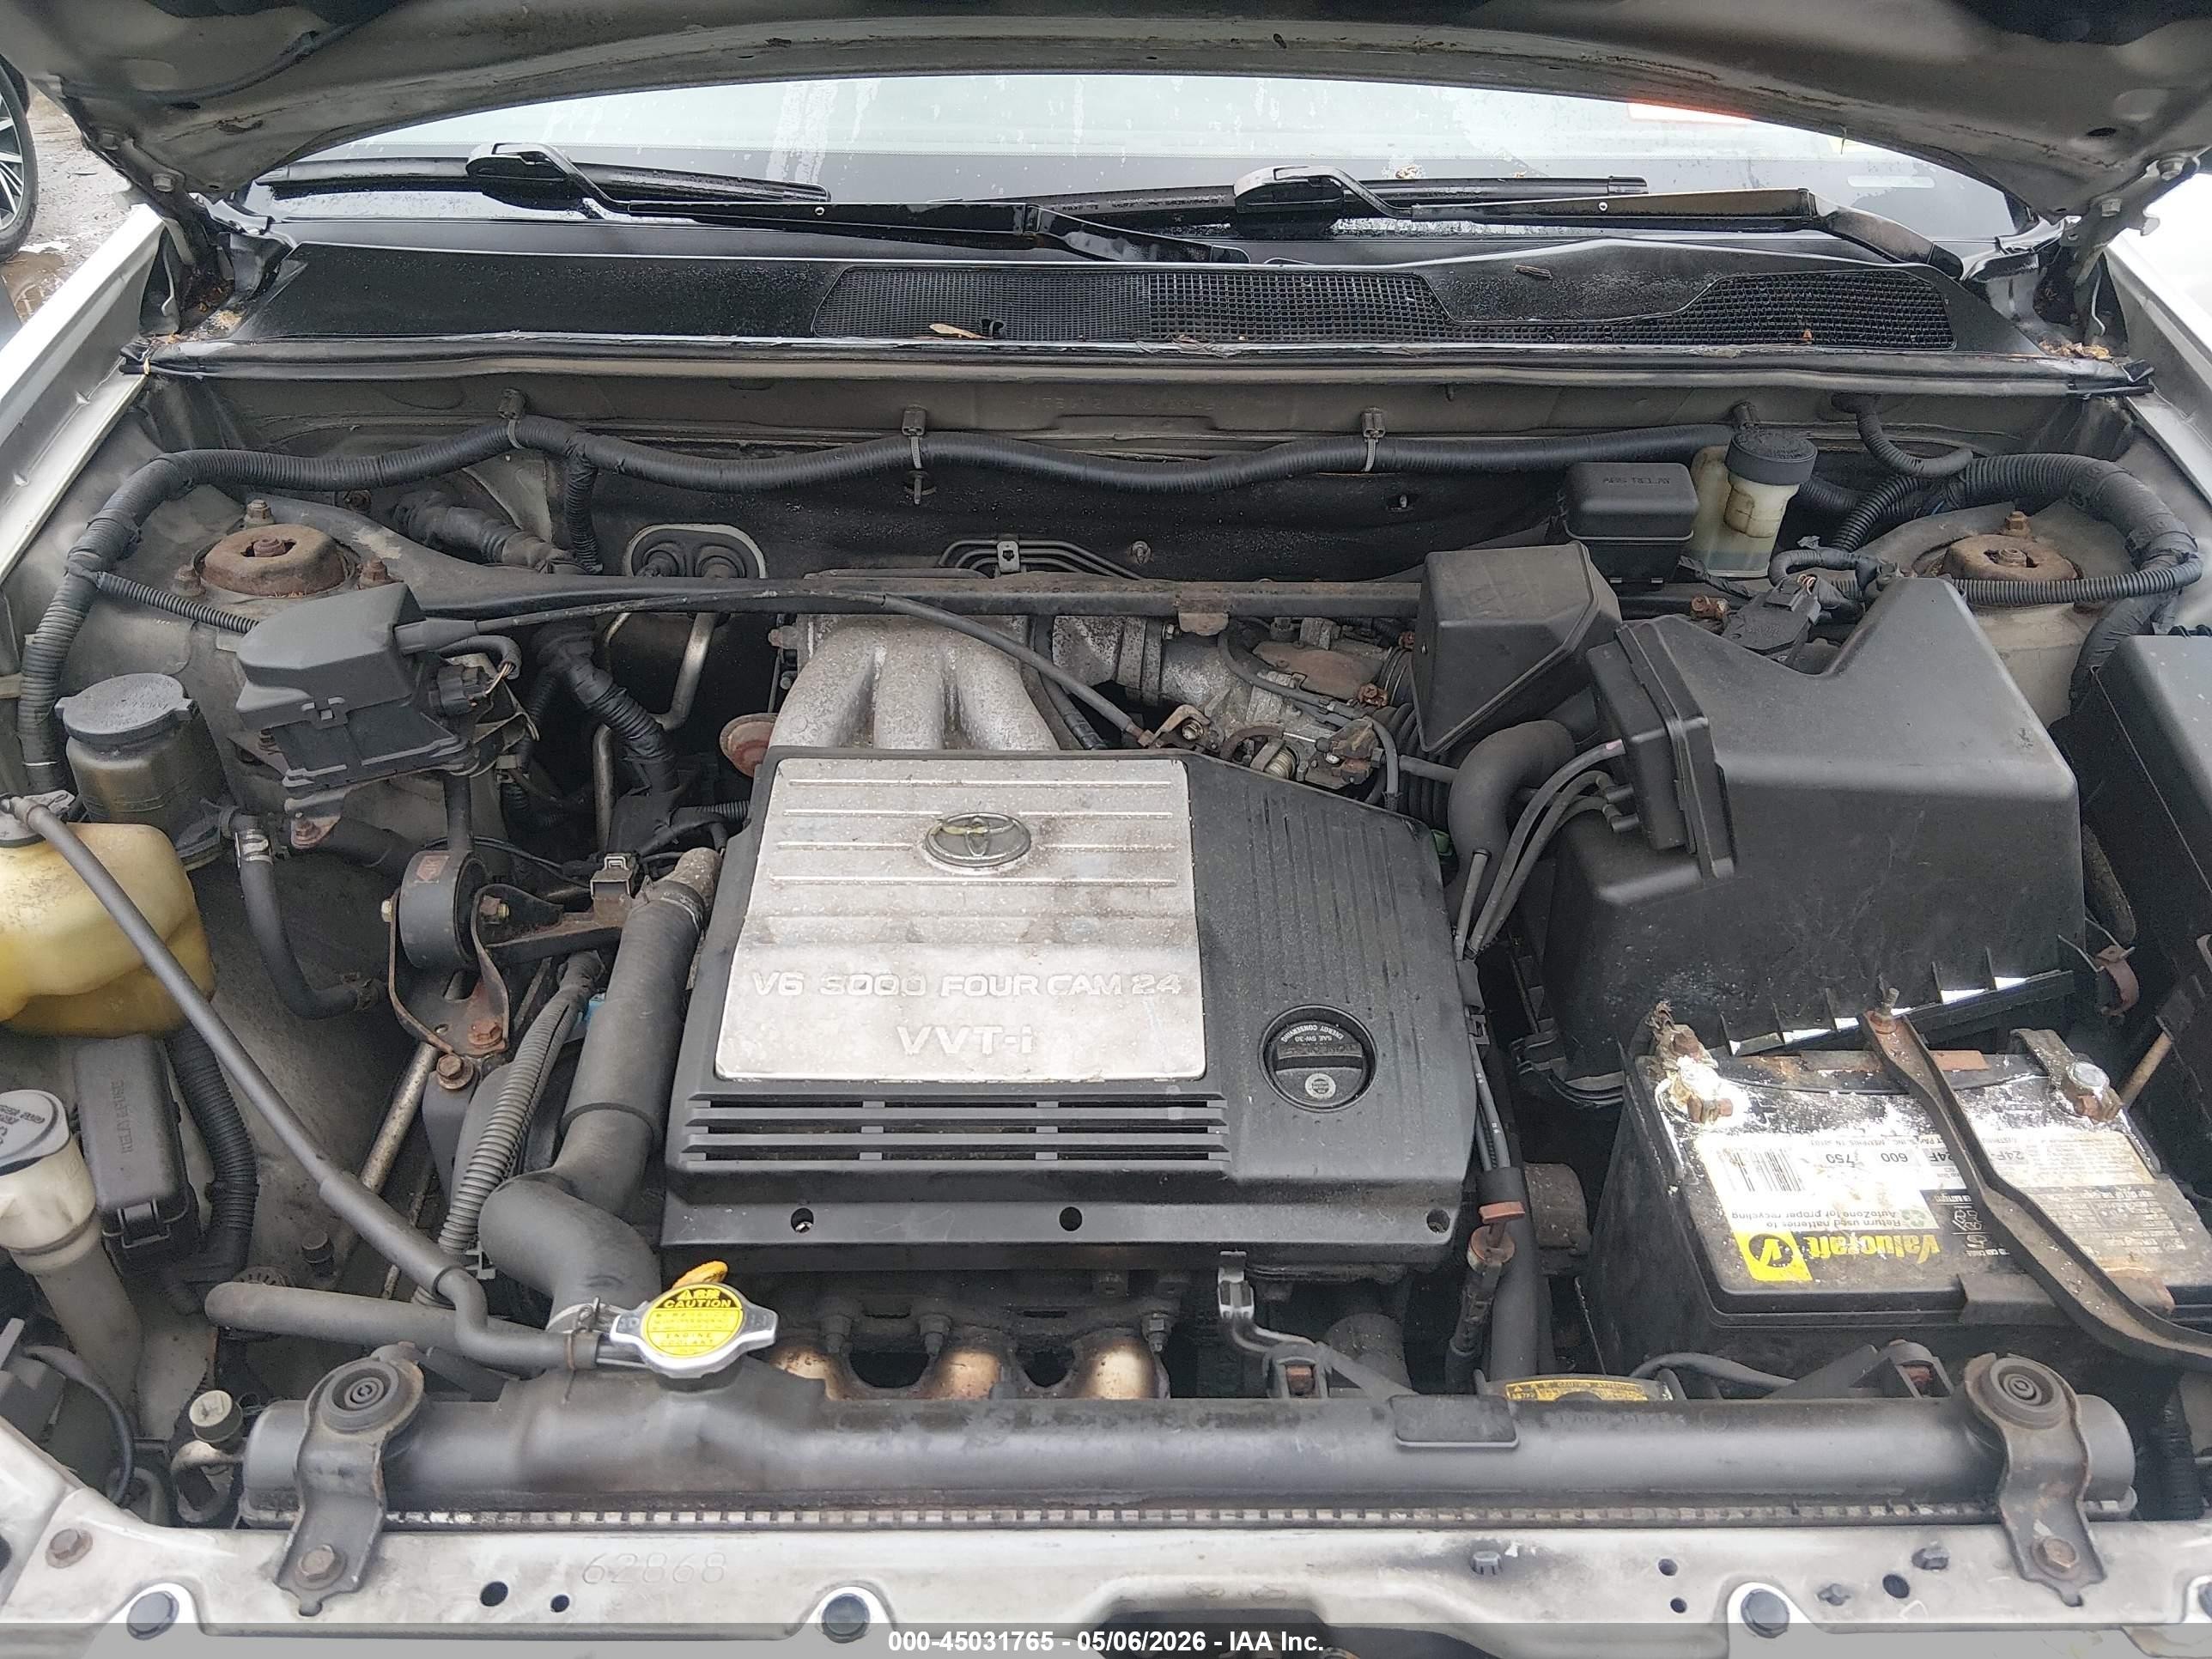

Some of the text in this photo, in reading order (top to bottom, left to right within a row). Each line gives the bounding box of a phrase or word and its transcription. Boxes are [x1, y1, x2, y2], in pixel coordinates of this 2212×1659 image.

[752, 971, 1182, 997] V6 3000 FOUR CAM 24
[1280, 1024, 1345, 1042] ENERGY CONSERVING
[896, 1024, 1034, 1055] VVT-i
[1826, 1153, 1852, 1164] 750
[1880, 1152, 1908, 1163] 600
[1732, 1211, 1781, 1219] recycling
[1785, 1210, 1821, 1218] proper
[1826, 1210, 1840, 1218] for
[1808, 1234, 1941, 1264] Valucraft
[664, 1299, 732, 1309] CAUTION
[582, 1552, 726, 1585] 62868
